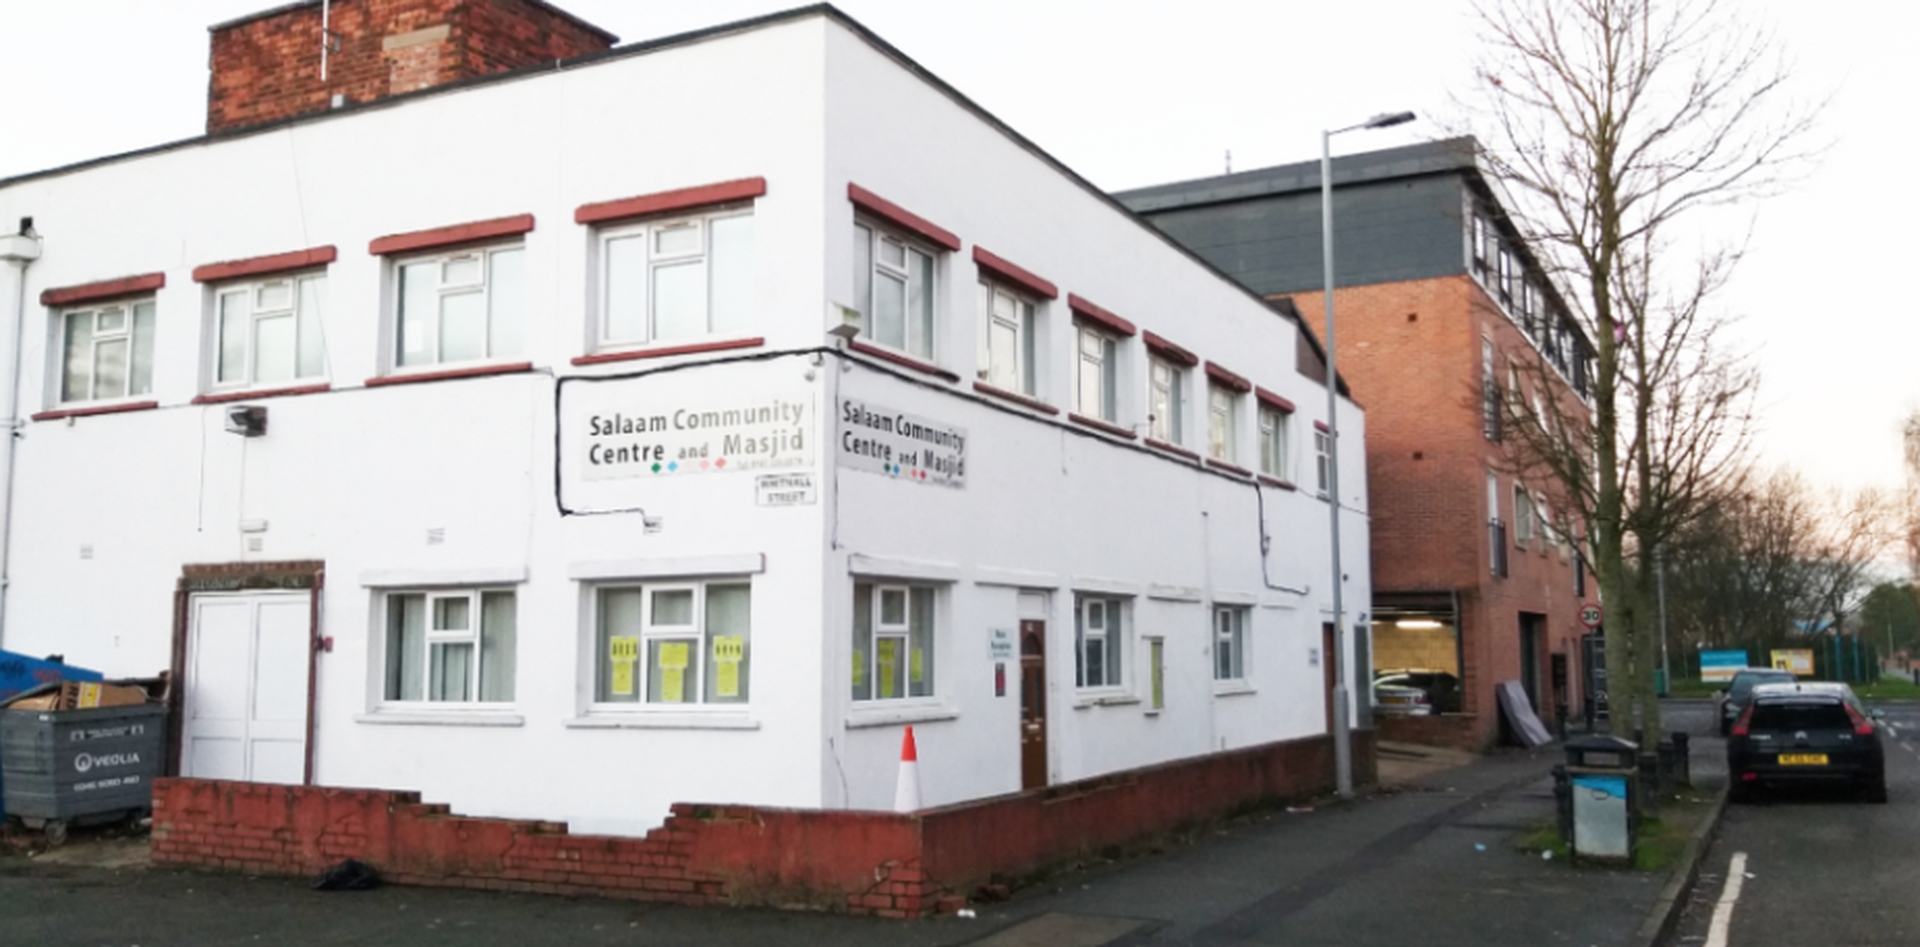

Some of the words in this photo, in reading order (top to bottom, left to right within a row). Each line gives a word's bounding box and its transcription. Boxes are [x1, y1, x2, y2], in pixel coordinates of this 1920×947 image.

[589, 412, 667, 437] Salaam
[673, 399, 804, 430] Community
[842, 400, 893, 433] Salaam
[895, 414, 965, 456] Community
[589, 442, 665, 466] Centre
[678, 442, 709, 460] and
[722, 427, 804, 459] Masjid
[842, 430, 892, 461] Centre
[899, 450, 917, 467] and
[923, 448, 964, 479] Masjid
[767, 490, 806, 503] STREET
[1582, 610, 1600, 621] 30
[92, 752, 140, 768] VEOLIA
